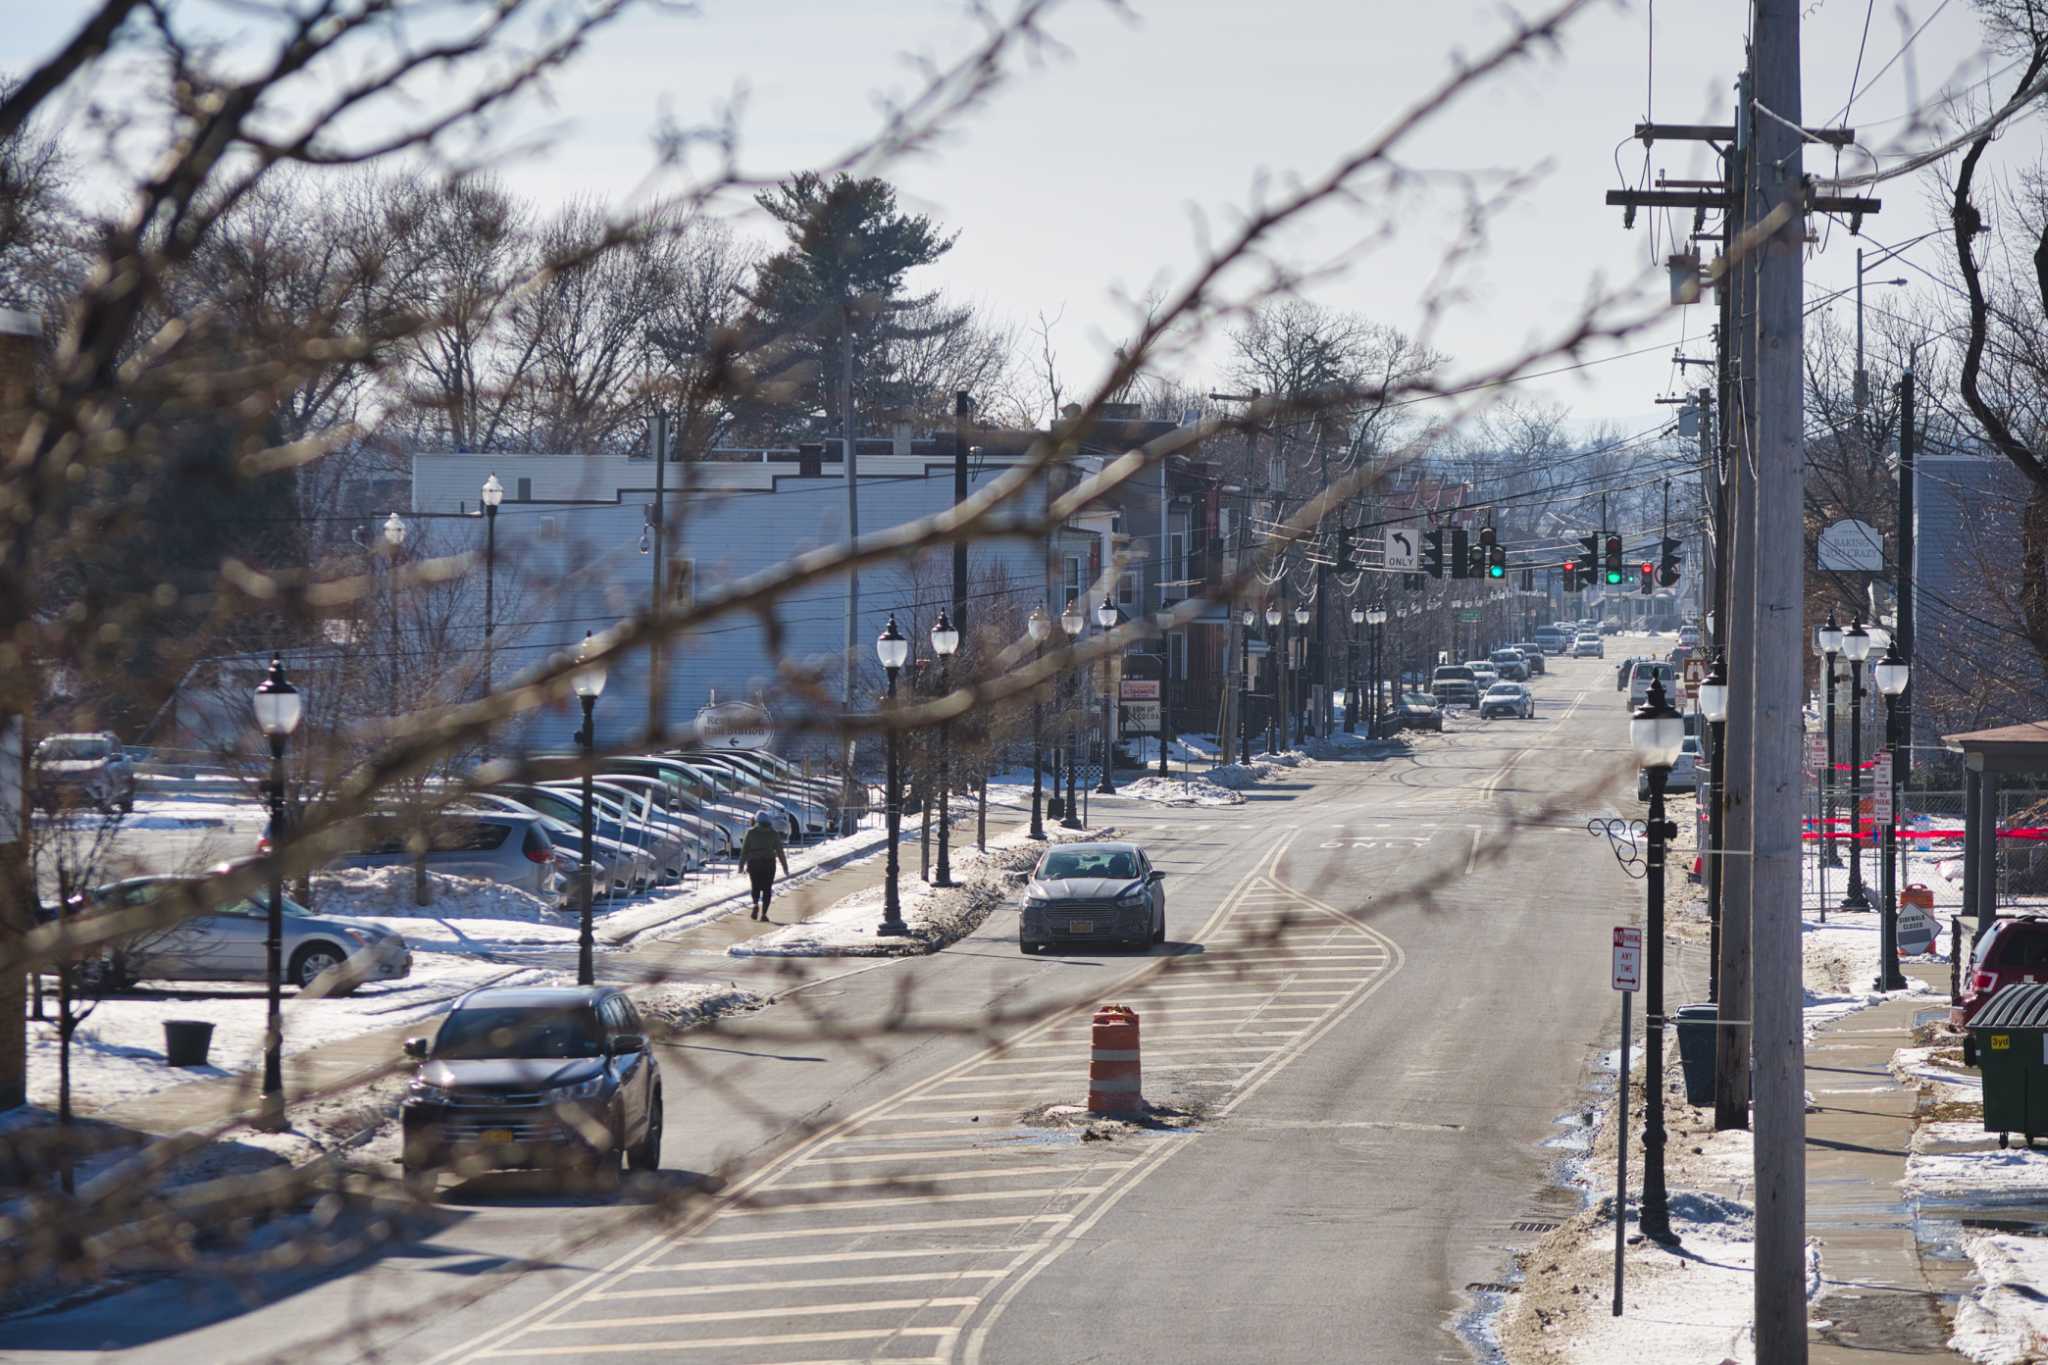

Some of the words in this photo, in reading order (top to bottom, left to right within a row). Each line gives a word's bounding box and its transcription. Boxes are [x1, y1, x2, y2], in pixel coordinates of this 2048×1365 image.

[1389, 557, 1415, 567] ONLY
[1898, 914, 1925, 924] SIDEWALK
[1903, 922, 1923, 930] CLOSED
[1621, 951, 1633, 961] ANY
[1620, 963, 1633, 974] TIME
